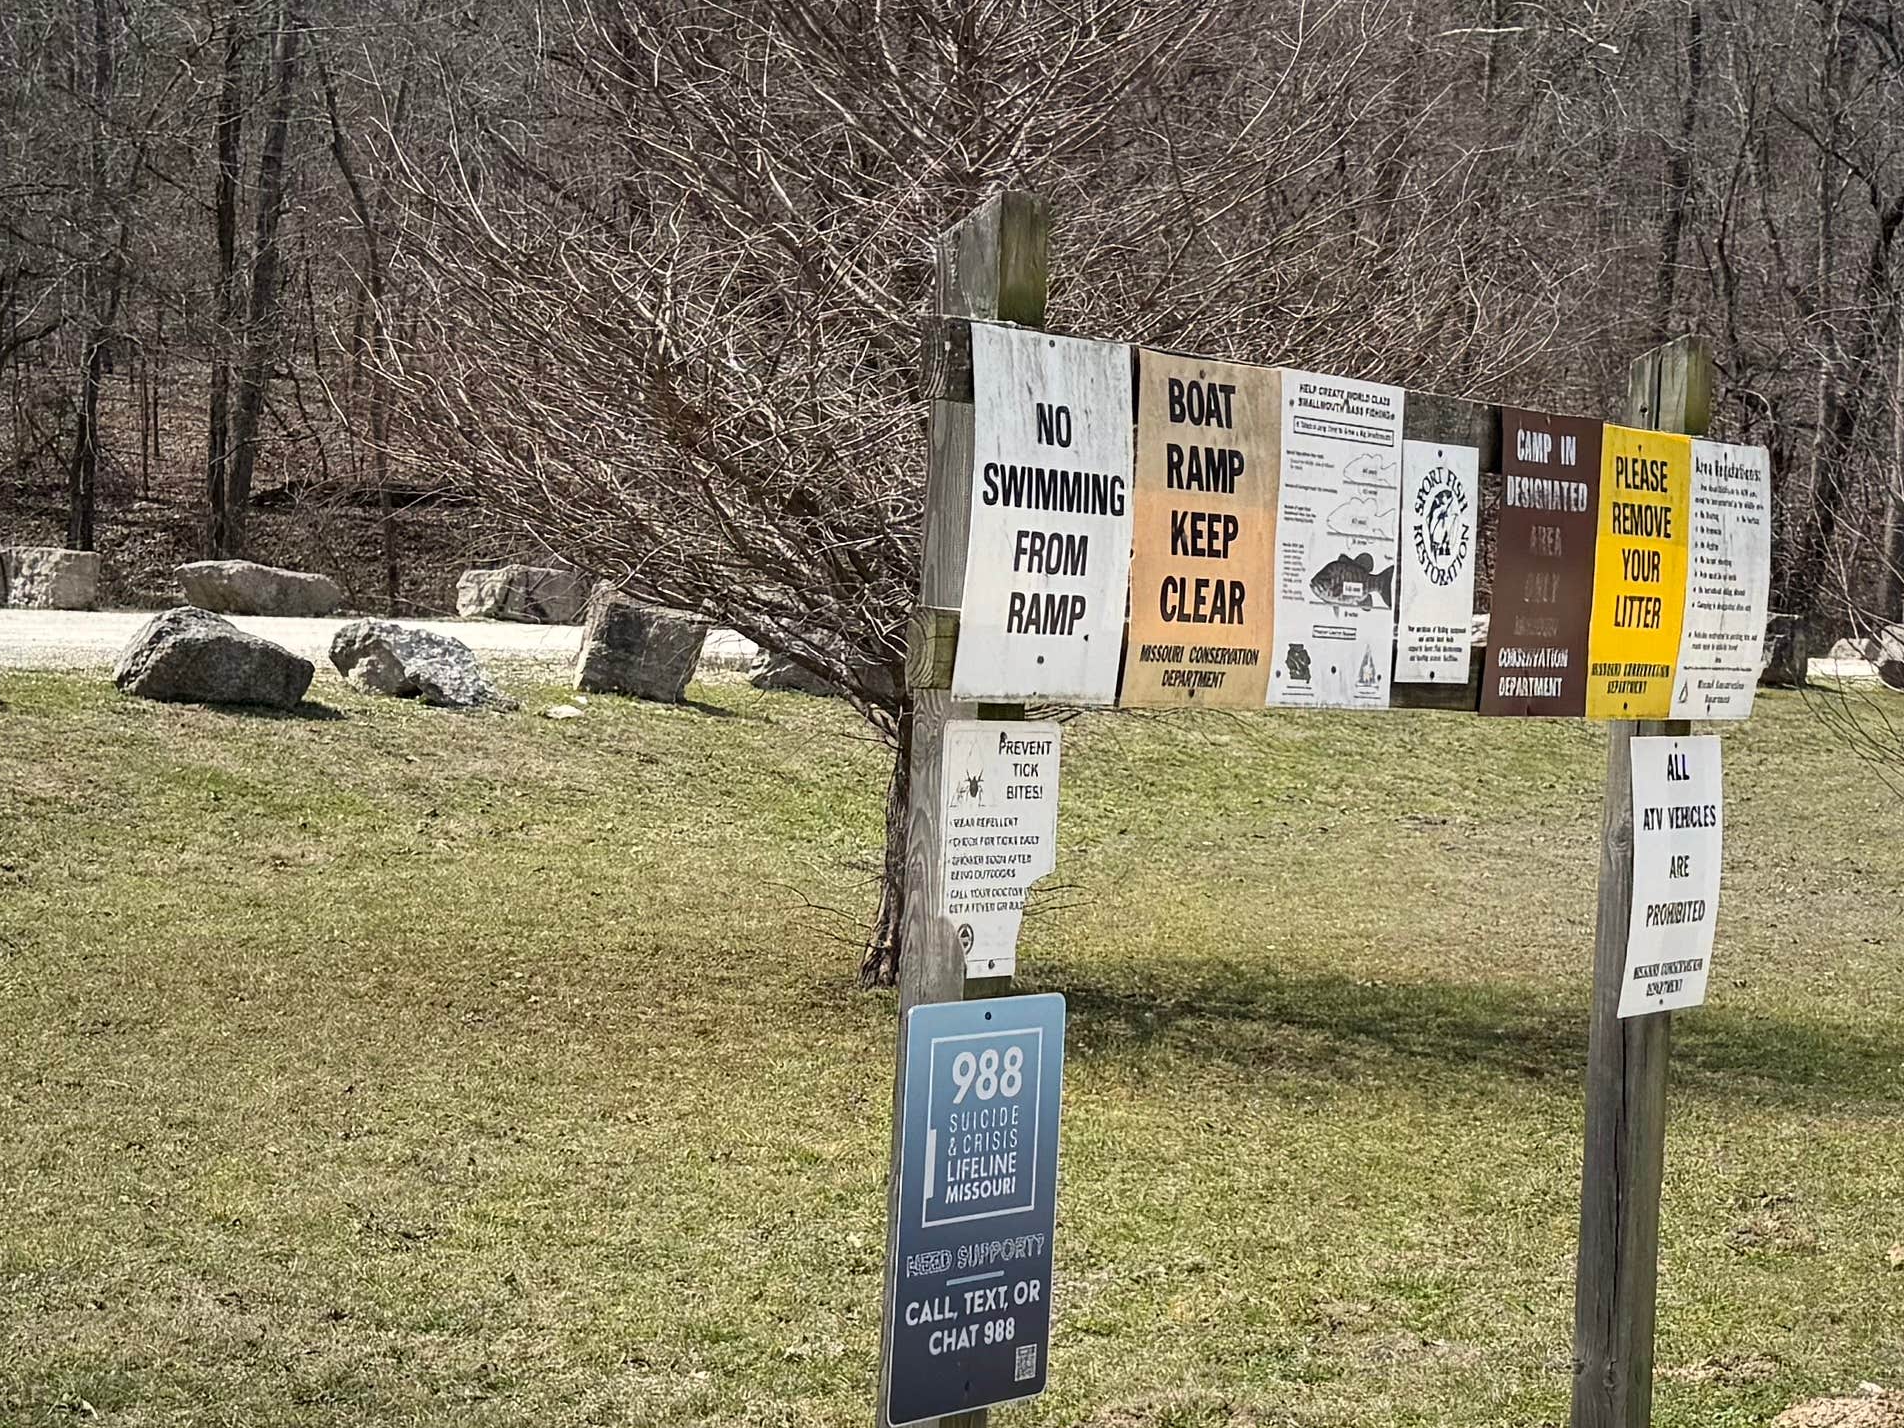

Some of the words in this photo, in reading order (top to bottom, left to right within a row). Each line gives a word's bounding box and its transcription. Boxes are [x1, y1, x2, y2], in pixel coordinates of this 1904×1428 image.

[1168, 377, 1236, 429] BOAT
[1035, 402, 1072, 448] NO
[1516, 428, 1552, 464] CAMP
[1560, 435, 1577, 466] IN
[1166, 443, 1245, 494] RAMP
[1615, 456, 1668, 493] PLEASE
[982, 462, 1125, 516] SWIMMING
[1415, 466, 1444, 516] SPORT
[1446, 468, 1468, 513] FISH
[1506, 474, 1588, 513] DESIGNATED
[1170, 509, 1239, 559] KEEP
[1612, 501, 1672, 539] REMOVE
[1013, 530, 1088, 576] FROM
[1413, 523, 1470, 586] RESTORATION
[1529, 525, 1562, 557] AREA
[1622, 548, 1661, 583] YOUR
[1006, 591, 1086, 636] RAMP
[1159, 575, 1245, 625] CLEAR
[1614, 595, 1661, 630] LITTER
[1139, 644, 1185, 664] MISSOURI
[1188, 646, 1260, 666] CONSERVATION
[1498, 647, 1569, 668] CONSERVATION
[1161, 669, 1226, 689] DEPARTMENT
[1498, 676, 1563, 697] DEPARTMENT
[998, 740, 1052, 755] PREVENT
[1012, 763, 1039, 777] TICK
[1666, 753, 1690, 782] ALL
[1006, 785, 1043, 800] BITES!
[1643, 807, 1663, 831] ATV
[1667, 805, 1716, 830] VEHICLES
[1669, 855, 1690, 879] ARE
[1646, 899, 1706, 927] PROHIBITED
[952, 1046, 1024, 1104] 988
[949, 1105, 1019, 1133] SUICIDE
[948, 1137, 957, 1157] &
[962, 1128, 1018, 1154] CRISIS
[947, 1151, 1017, 1183] LIFELINE
[945, 1175, 1016, 1204] MISSOURI
[906, 1249, 953, 1278] NEED
[905, 1296, 958, 1326] CALL,
[964, 1285, 1008, 1316] TEXT,
[1014, 1279, 1040, 1305] OR
[928, 1323, 980, 1356] CHAT
[984, 1317, 1015, 1345] 988
